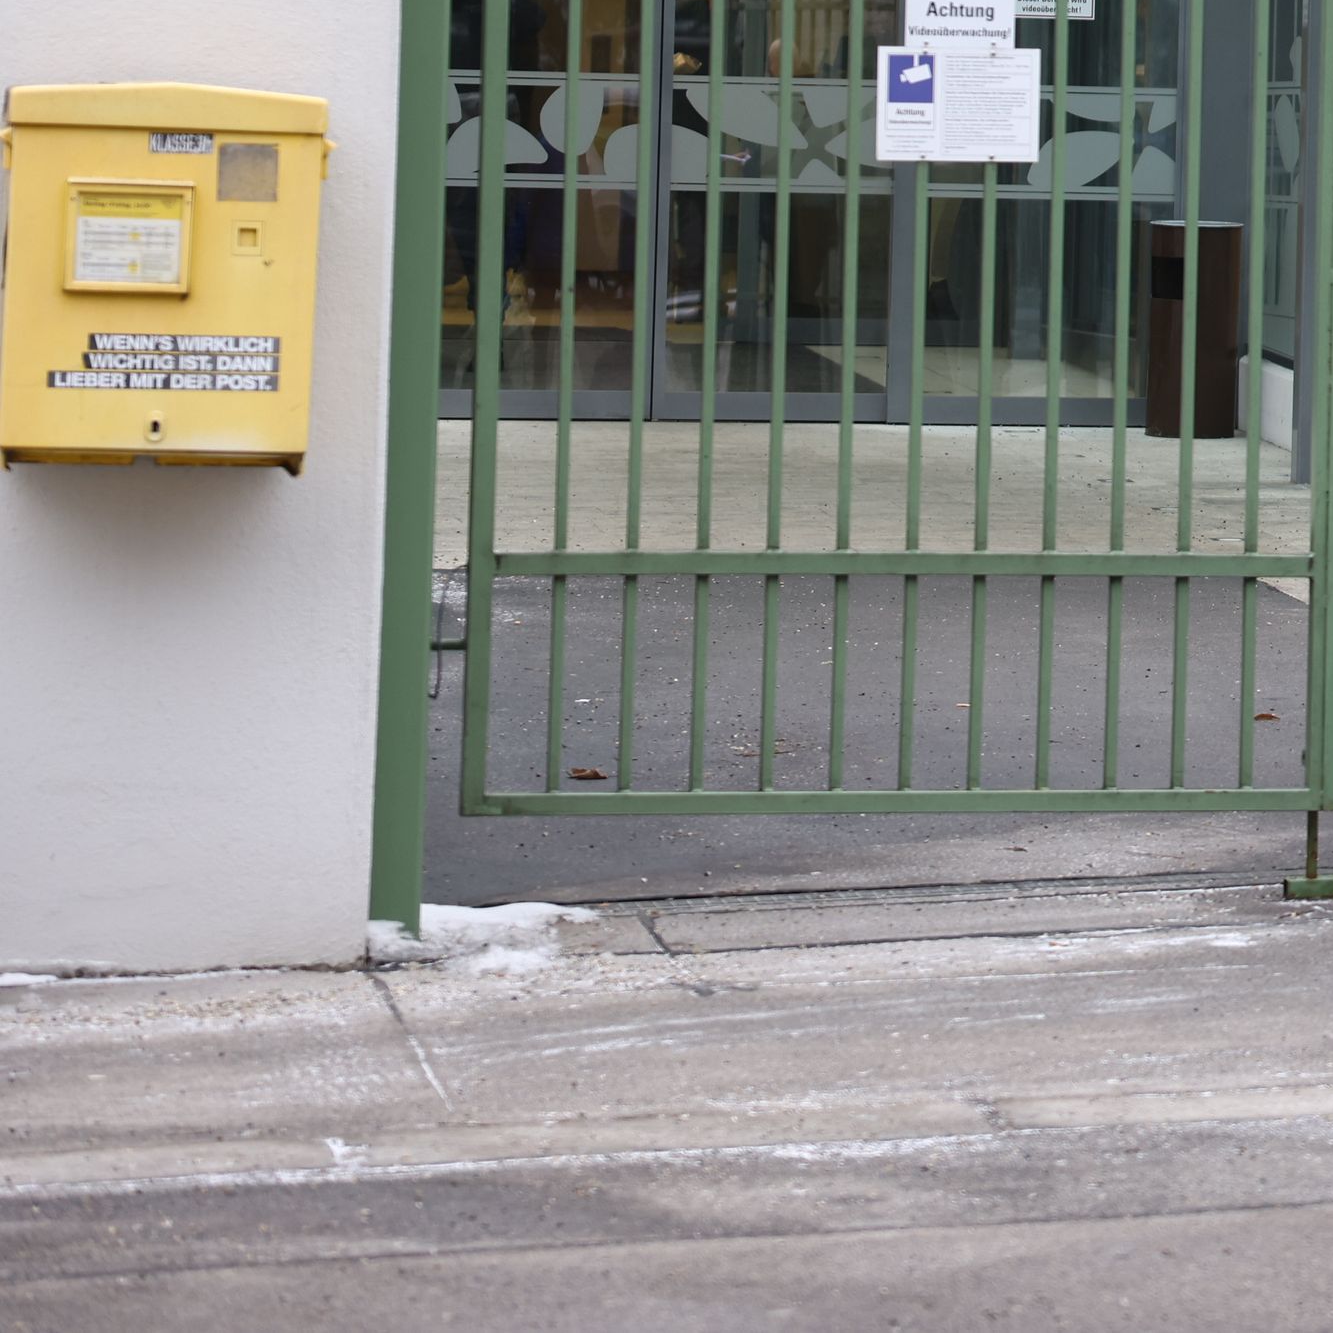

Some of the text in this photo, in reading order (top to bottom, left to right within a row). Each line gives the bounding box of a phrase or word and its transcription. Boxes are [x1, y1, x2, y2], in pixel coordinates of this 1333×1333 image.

[926, 1, 995, 22] Achtung
[1022, 5, 1082, 13] videoübercht!
[94, 334, 274, 353] WENN'S WIRKLICH
[88, 353, 177, 370] WICHTIG
[216, 355, 273, 371] DANN
[54, 372, 273, 391] LIEBER MIT DER POST.
